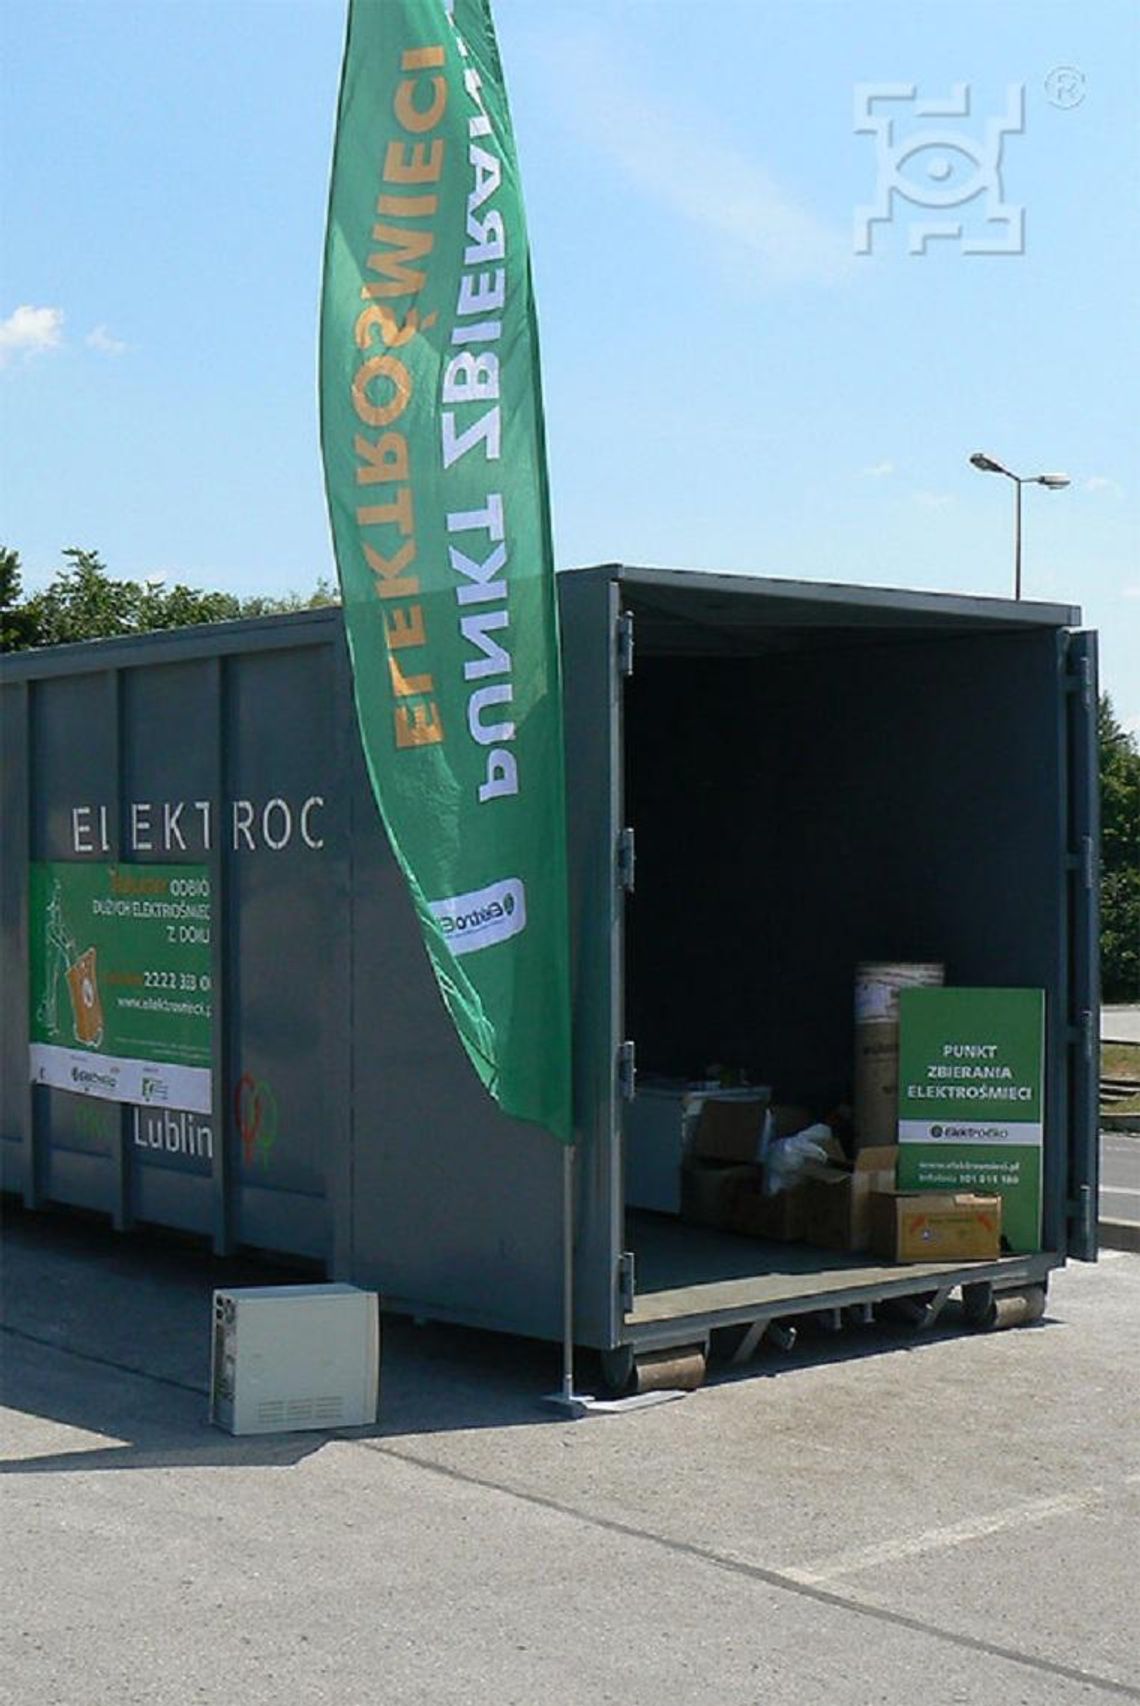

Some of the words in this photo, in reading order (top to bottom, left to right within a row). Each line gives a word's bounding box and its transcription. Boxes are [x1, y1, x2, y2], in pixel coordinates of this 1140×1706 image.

[943, 1045, 998, 1058] PUNKT
[927, 1065, 1013, 1079] ZBIERANIA
[133, 1106, 214, 1158] Lublin
